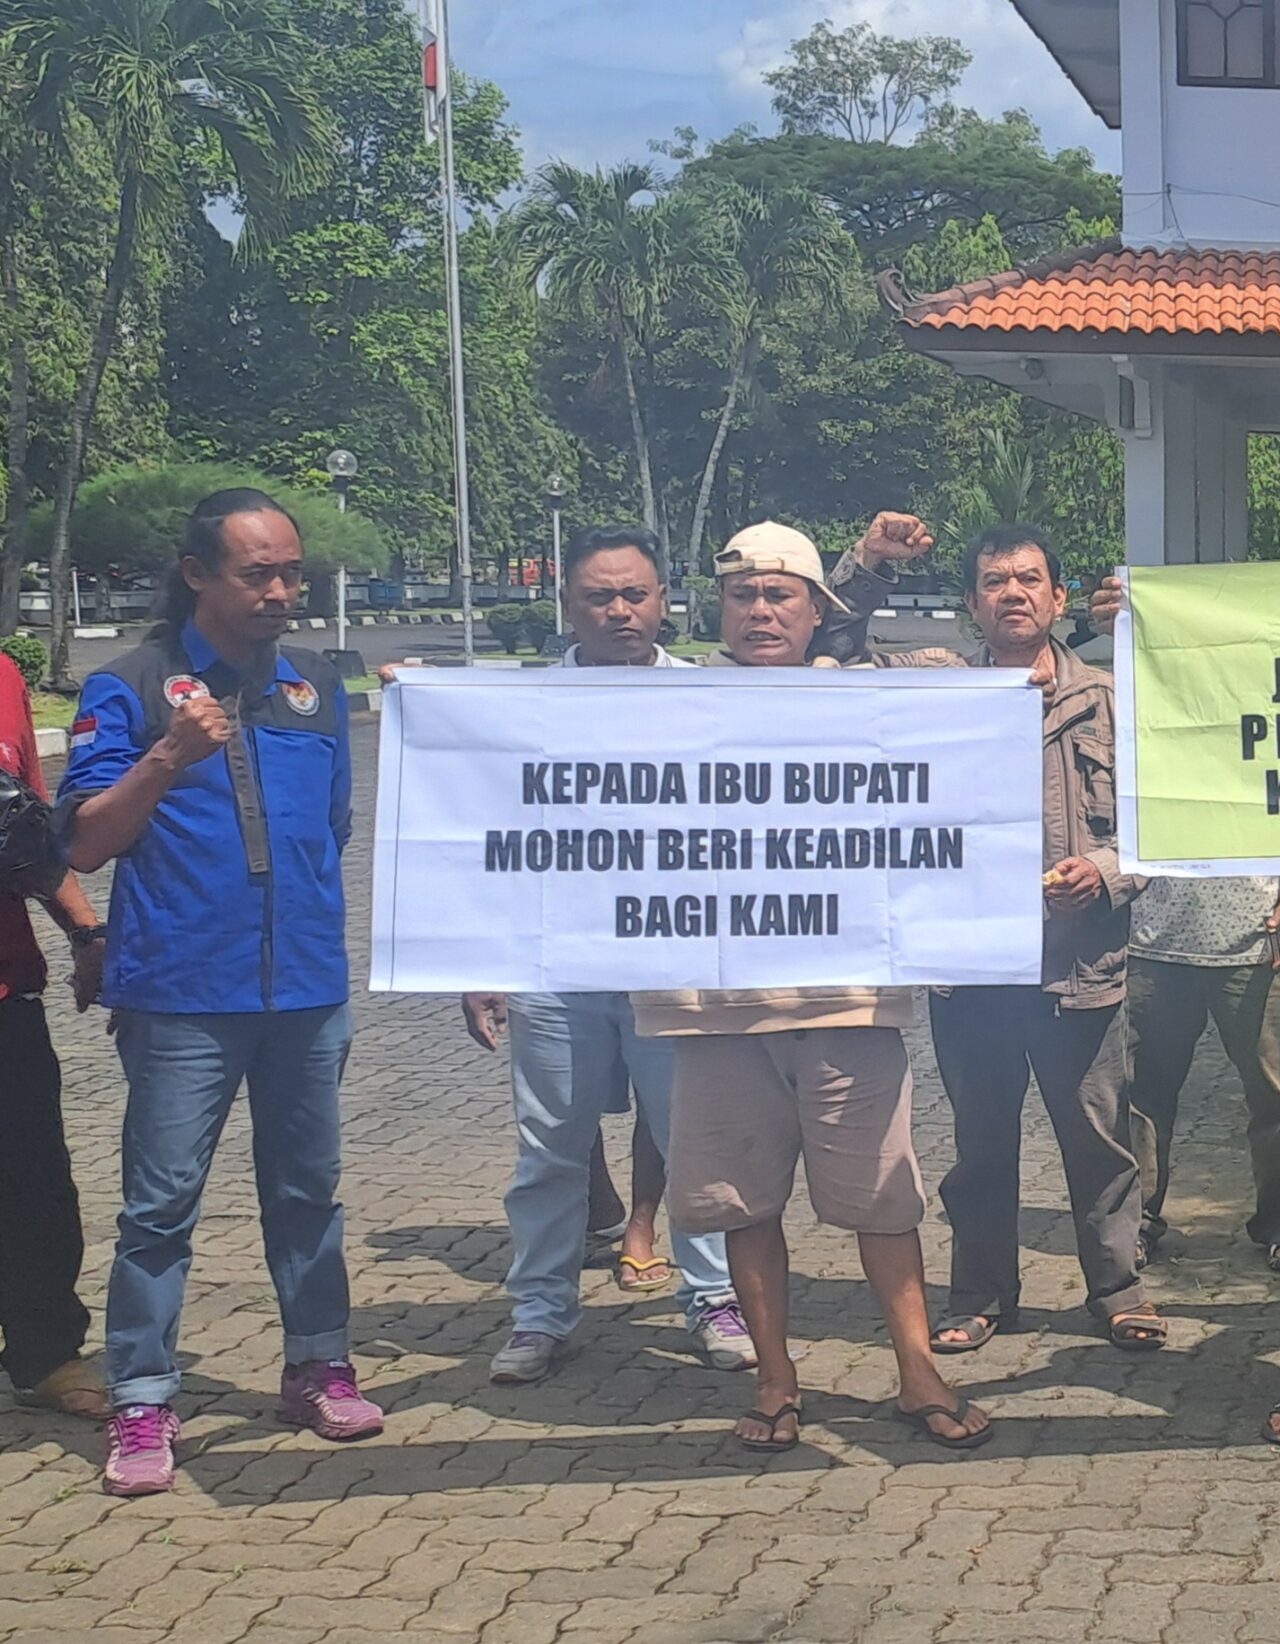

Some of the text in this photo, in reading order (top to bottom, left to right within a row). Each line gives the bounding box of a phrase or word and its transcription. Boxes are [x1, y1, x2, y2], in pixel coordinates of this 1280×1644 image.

[522, 762, 929, 805] KEPADA IBU BUPATI
[485, 827, 963, 872] MOHON BERI KEADILAN
[615, 893, 838, 938] BAGI KAMI
